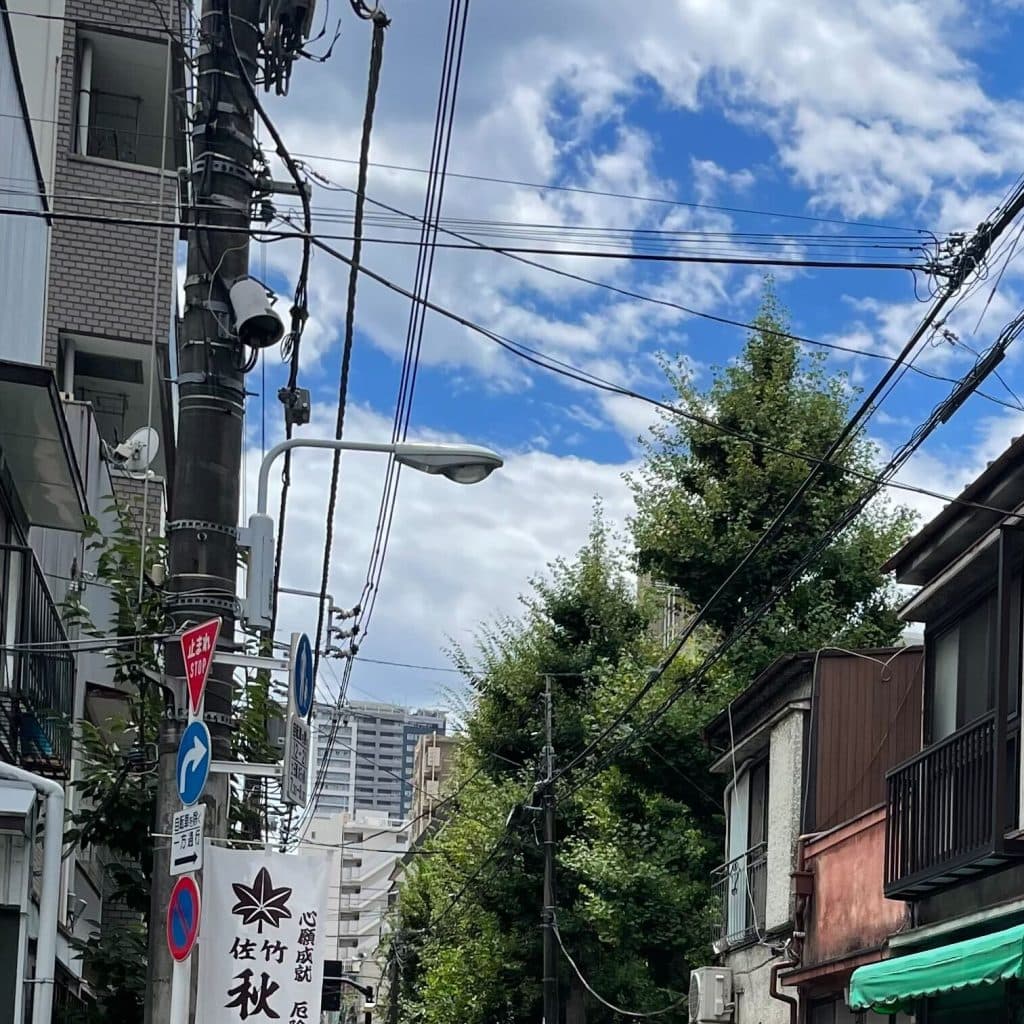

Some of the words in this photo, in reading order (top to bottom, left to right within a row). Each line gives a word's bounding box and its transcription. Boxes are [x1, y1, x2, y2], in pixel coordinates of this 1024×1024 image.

[187, 632, 210, 659] 止まれ
[190, 657, 207, 678] STOP
[228, 936, 288, 965] 佐竹
[294, 910, 317, 983] 心願成就
